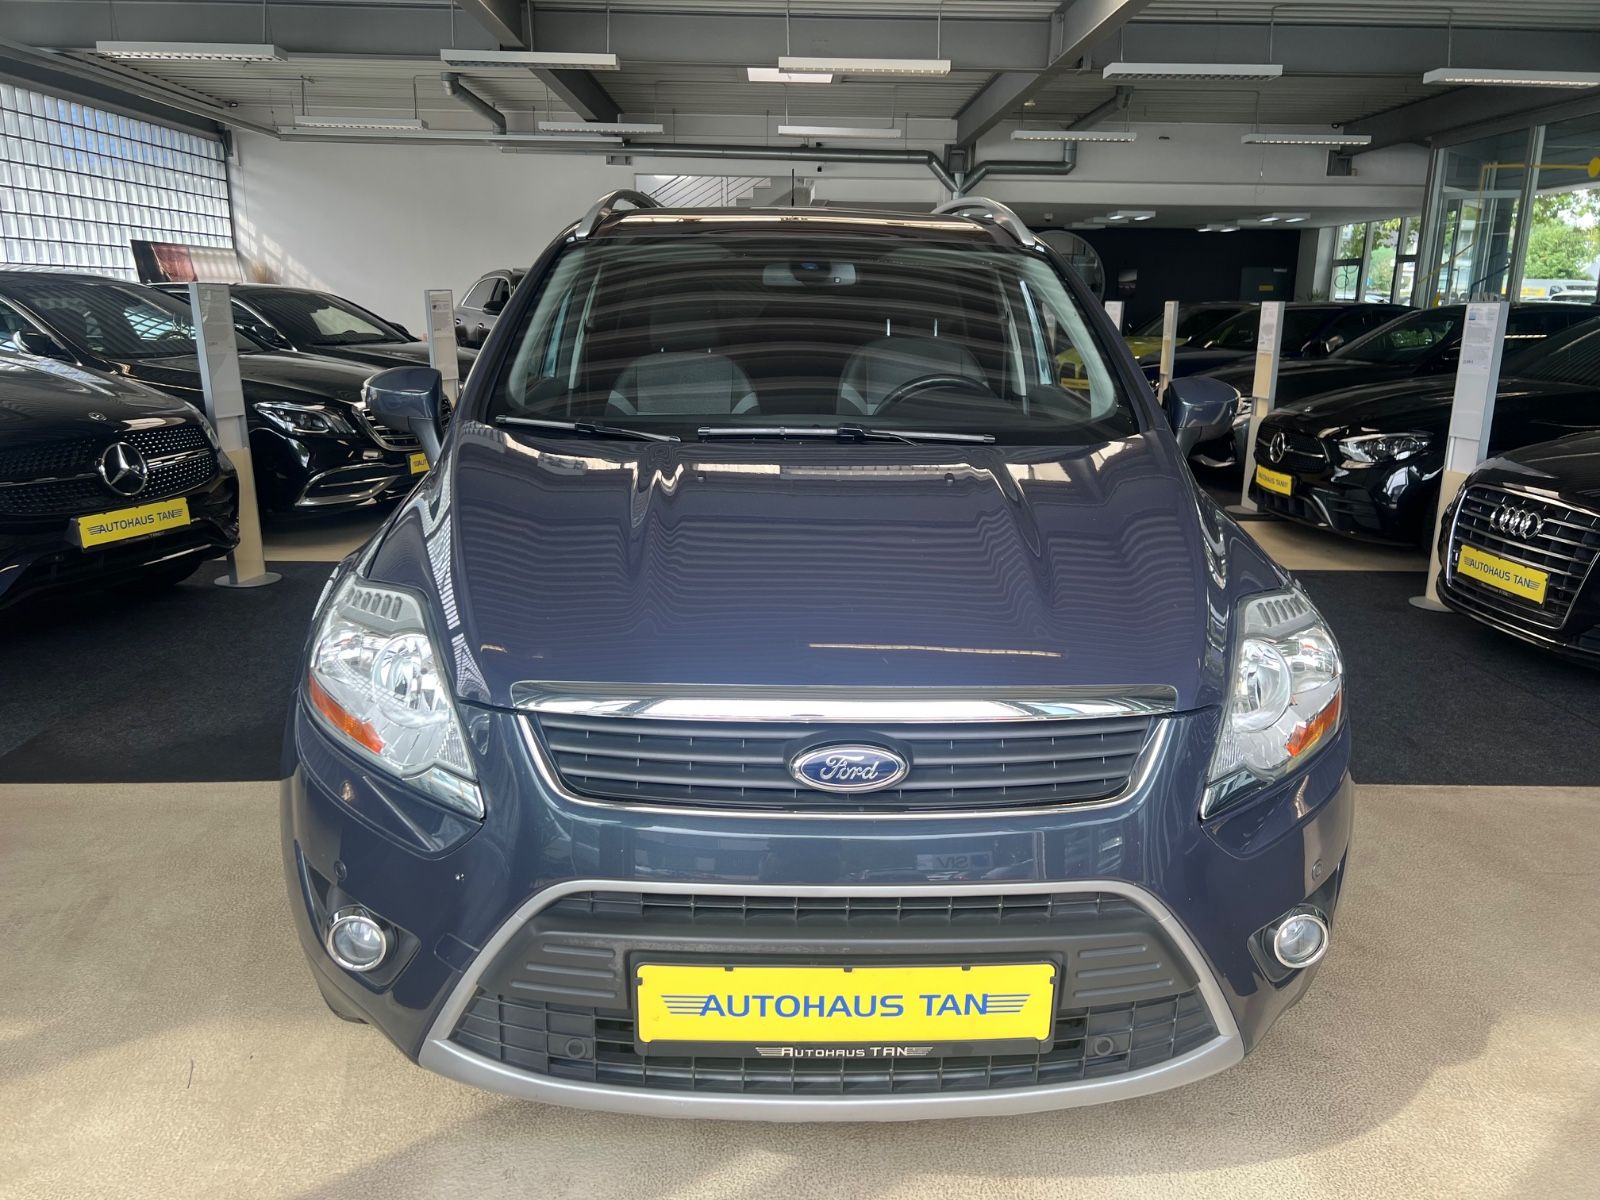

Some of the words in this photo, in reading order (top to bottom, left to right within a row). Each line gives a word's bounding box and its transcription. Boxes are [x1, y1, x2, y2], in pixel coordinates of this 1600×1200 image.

[99, 514, 155, 534] AUTOHAUS
[157, 510, 175, 521] TAN
[1469, 560, 1511, 581] AUTOHAUS
[1514, 575, 1531, 588] TAN
[820, 754, 880, 780] Ford
[699, 994, 905, 1018] AUTOHAUS
[919, 993, 989, 1016] TAN
[870, 1046, 908, 1057] TAN
